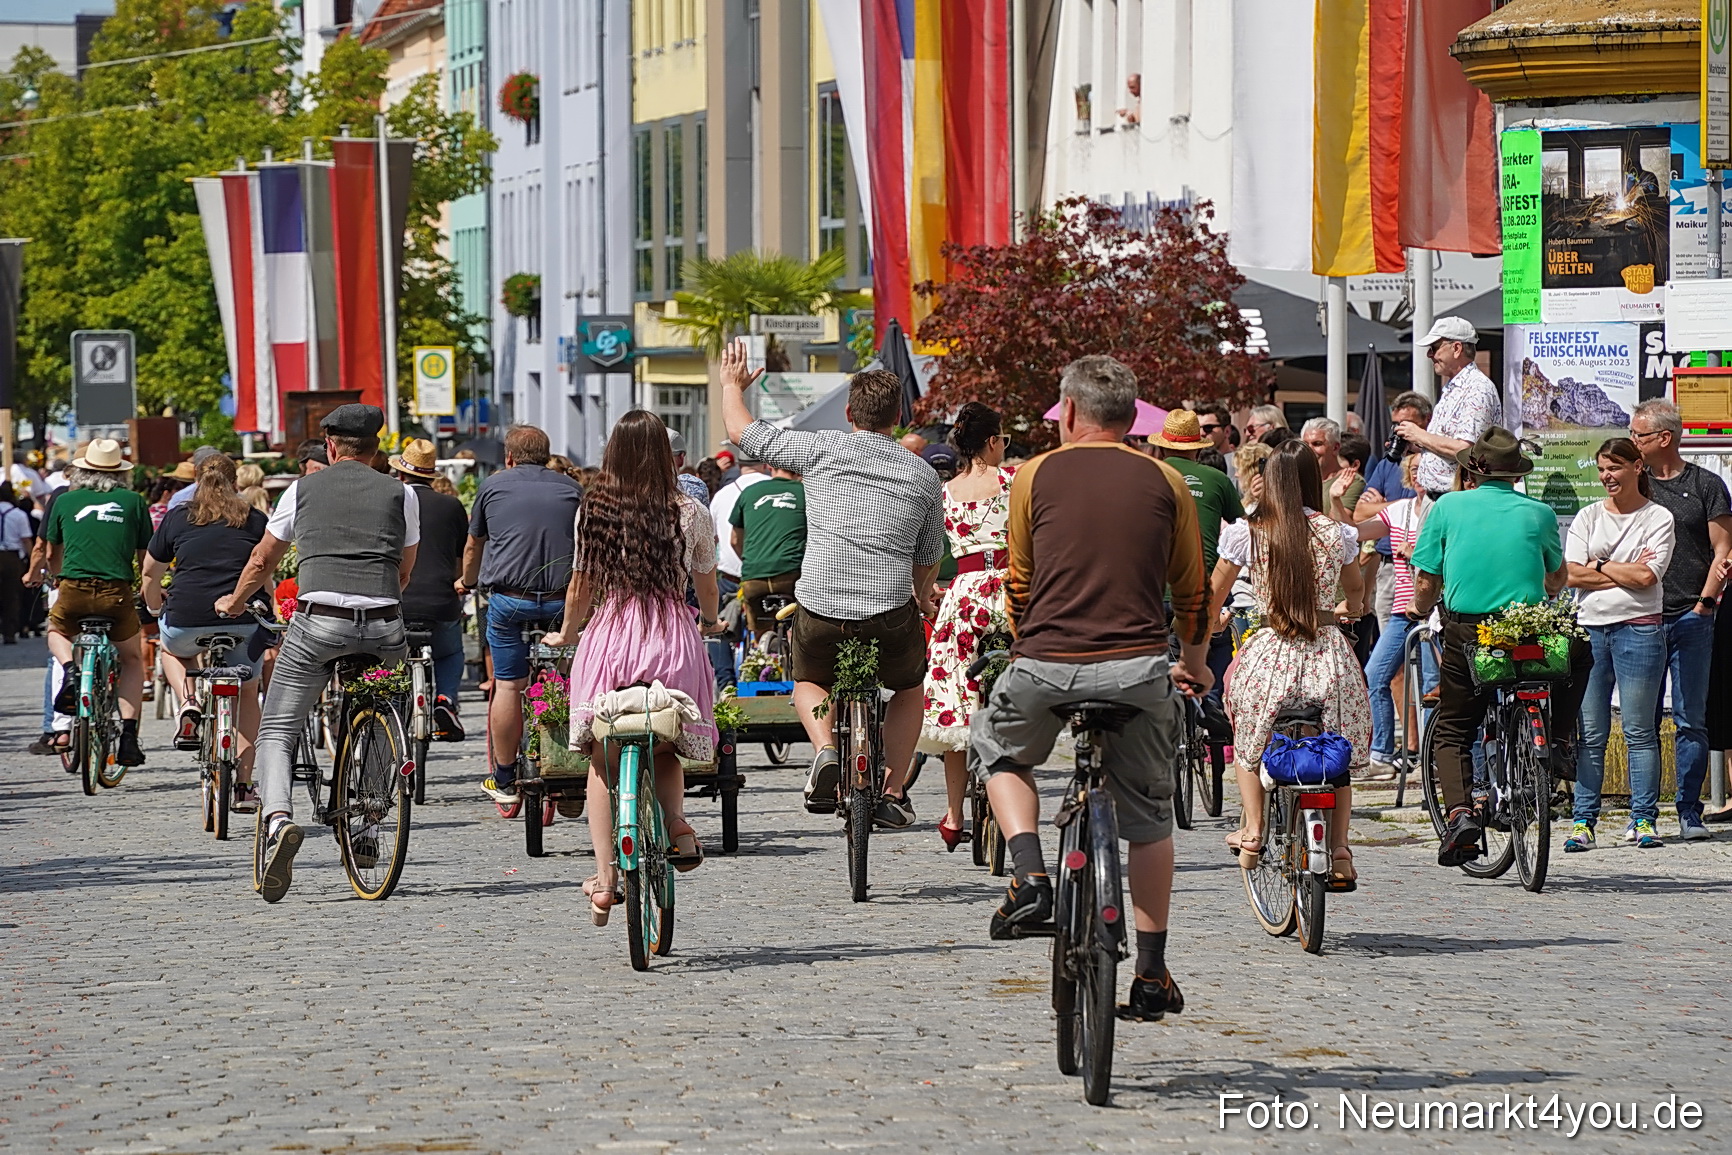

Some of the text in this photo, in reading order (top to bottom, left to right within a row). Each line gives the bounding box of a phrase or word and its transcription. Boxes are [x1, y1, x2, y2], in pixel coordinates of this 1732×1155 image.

[1548, 249, 1579, 263] ÜBER
[1548, 263, 1593, 275] WELTEN
[1626, 267, 1654, 276] STADT
[1626, 275, 1651, 284] MUSE
[765, 318, 819, 330] Klostergasse
[1529, 331, 1599, 344] FELSENFEST
[1533, 345, 1629, 358] DEINSCHWANG
[1579, 358, 1606, 368] August
[1609, 358, 1631, 366] 2023
